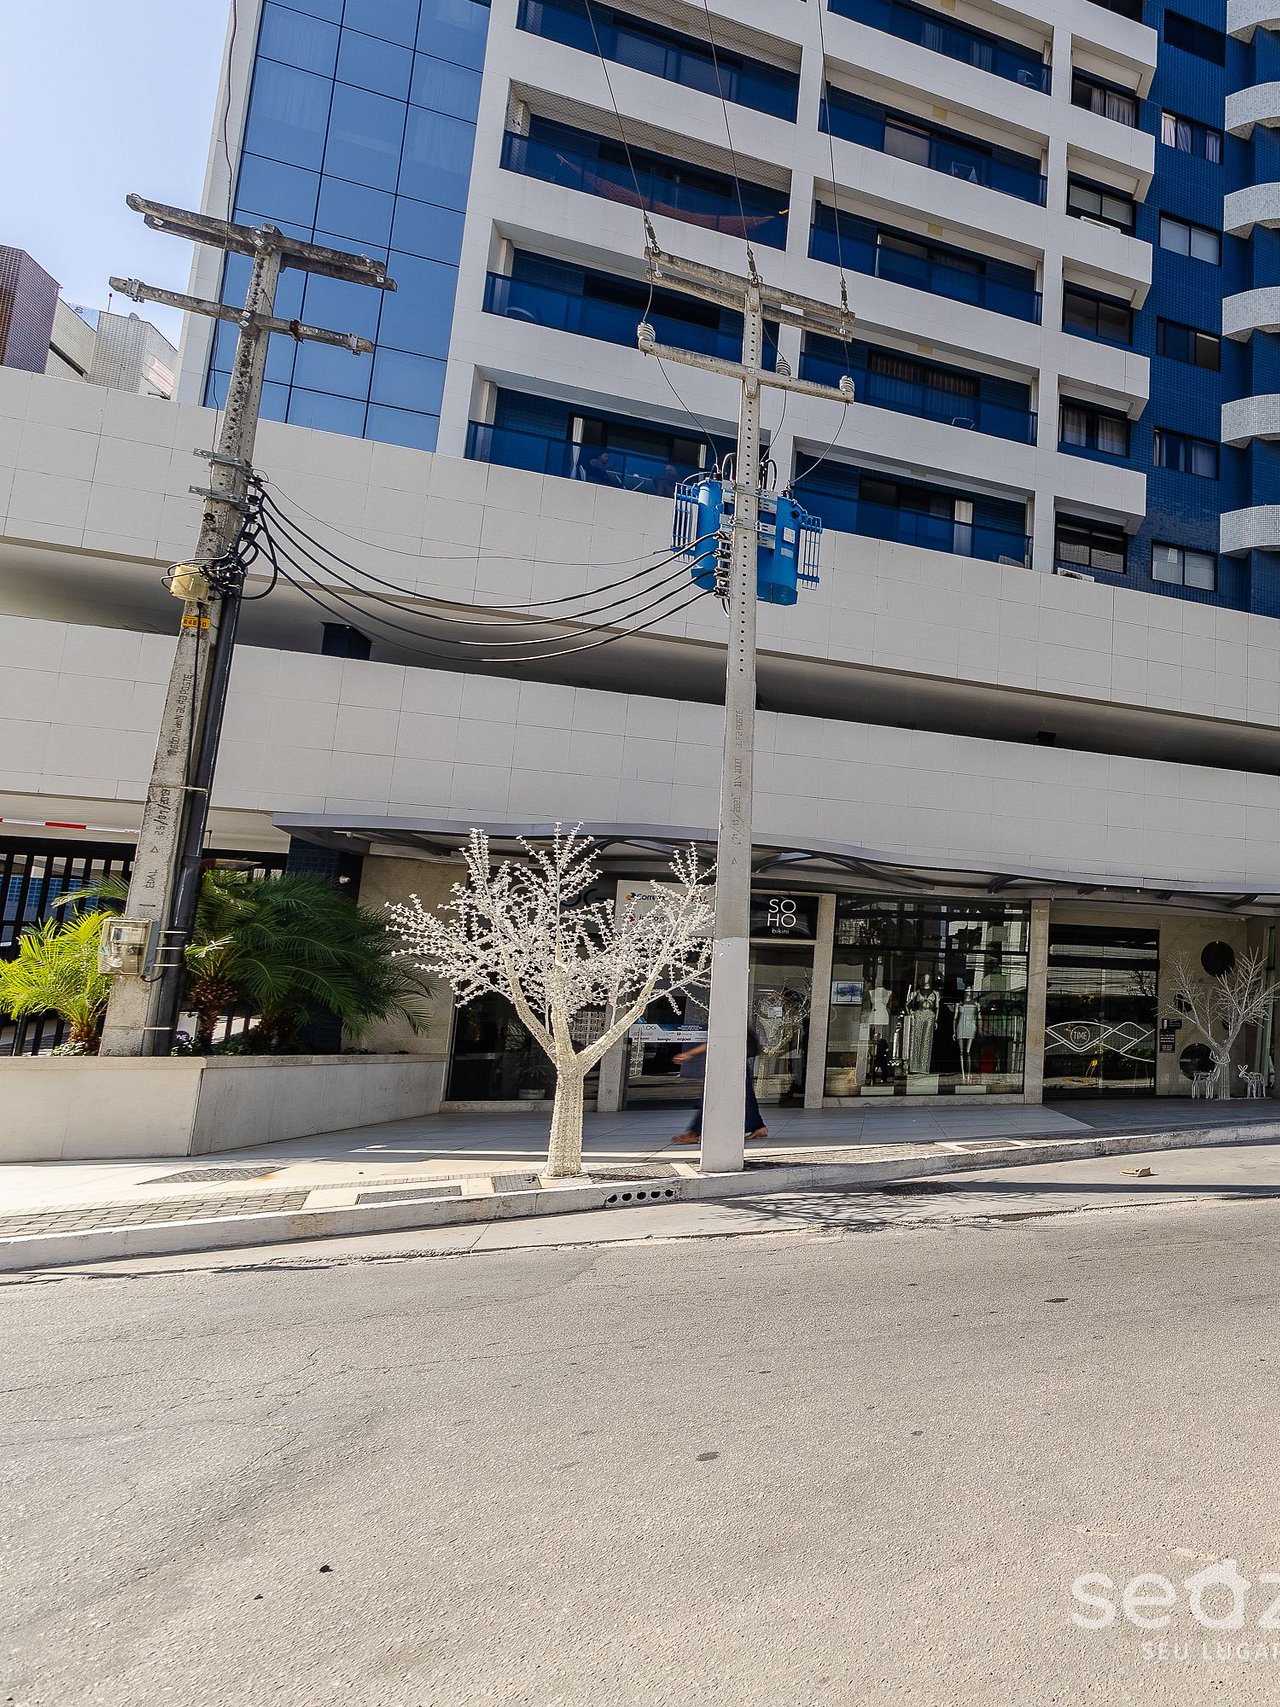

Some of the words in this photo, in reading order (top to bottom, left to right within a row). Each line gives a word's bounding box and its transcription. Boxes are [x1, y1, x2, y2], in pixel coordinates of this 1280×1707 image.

[768, 898, 797, 914] SO
[766, 912, 797, 928] HO
[1073, 1031, 1088, 1041] TIME
